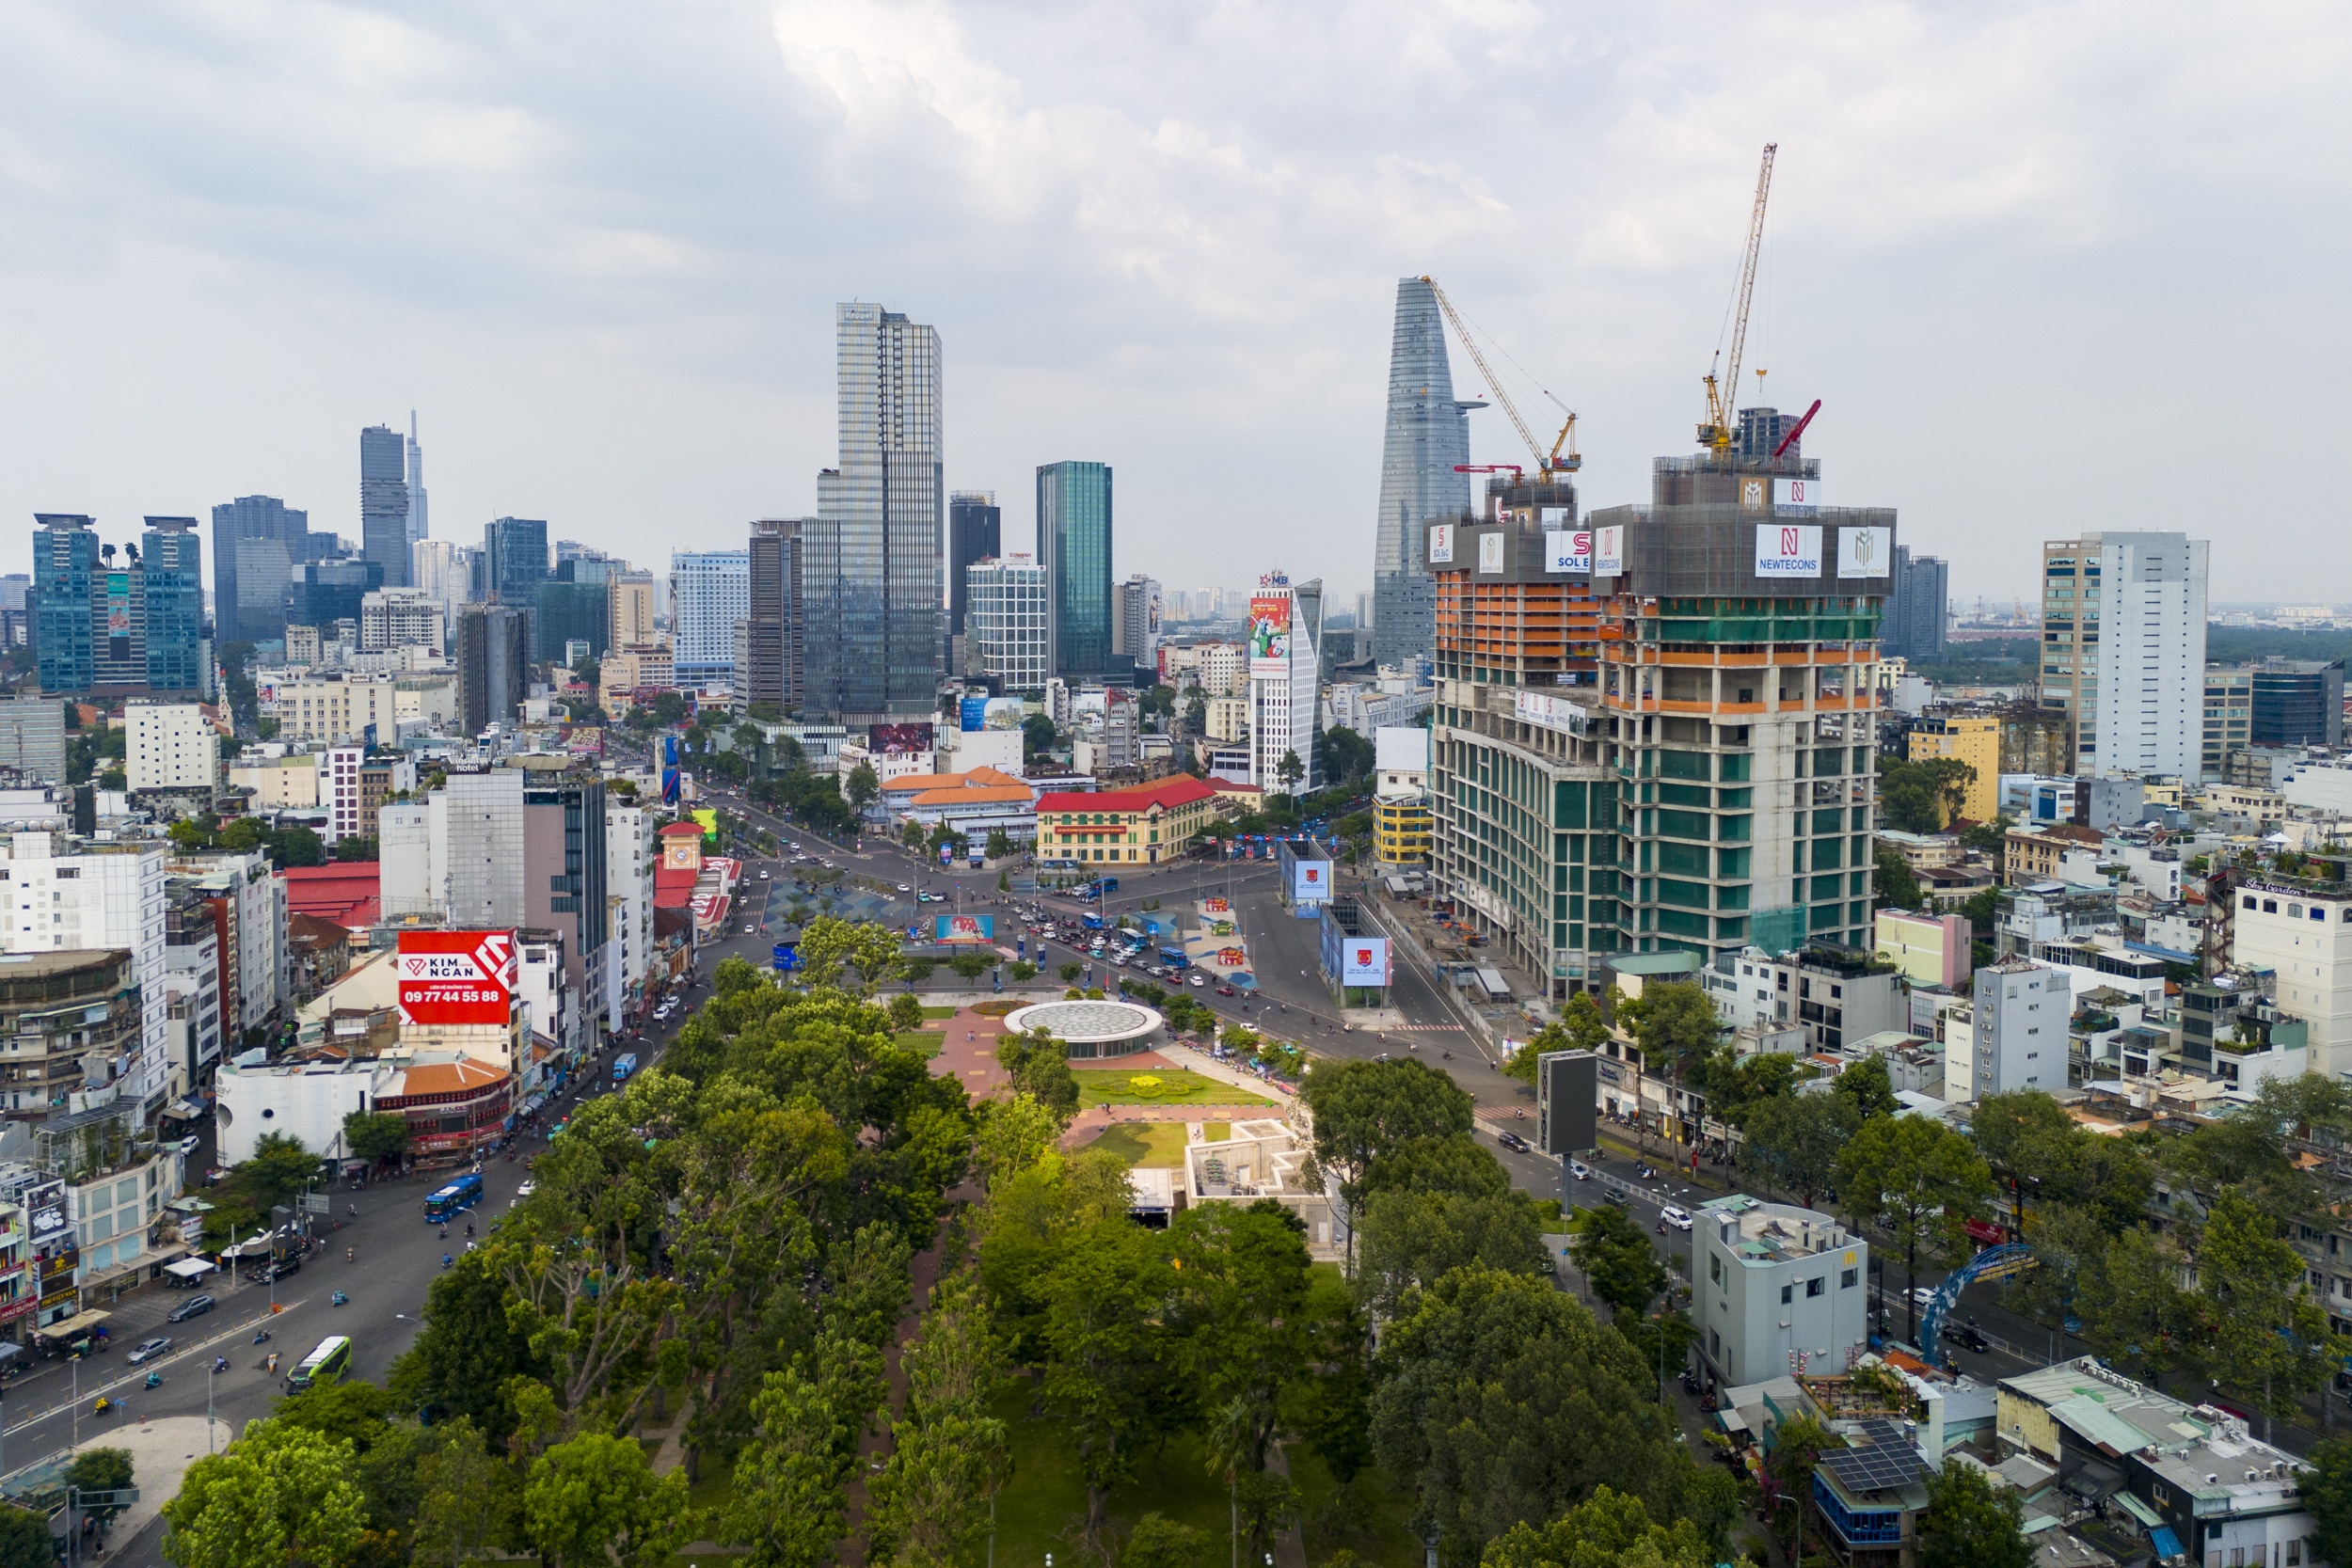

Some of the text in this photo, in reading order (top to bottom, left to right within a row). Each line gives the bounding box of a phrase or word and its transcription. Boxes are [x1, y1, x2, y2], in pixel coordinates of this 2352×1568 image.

[1777, 504, 1818, 513] NEWTECONS
[1558, 557, 1581, 567] SOL
[1597, 559, 1620, 570] NEWTECONS
[1759, 559, 1817, 570] NEWTECONS
[1272, 576, 1288, 584] MB
[2245, 878, 2301, 896] Sky Garden
[430, 958, 458, 967] KIM
[430, 968, 473, 976] NGAN
[405, 990, 499, 1003] 09 77 44 55 88
